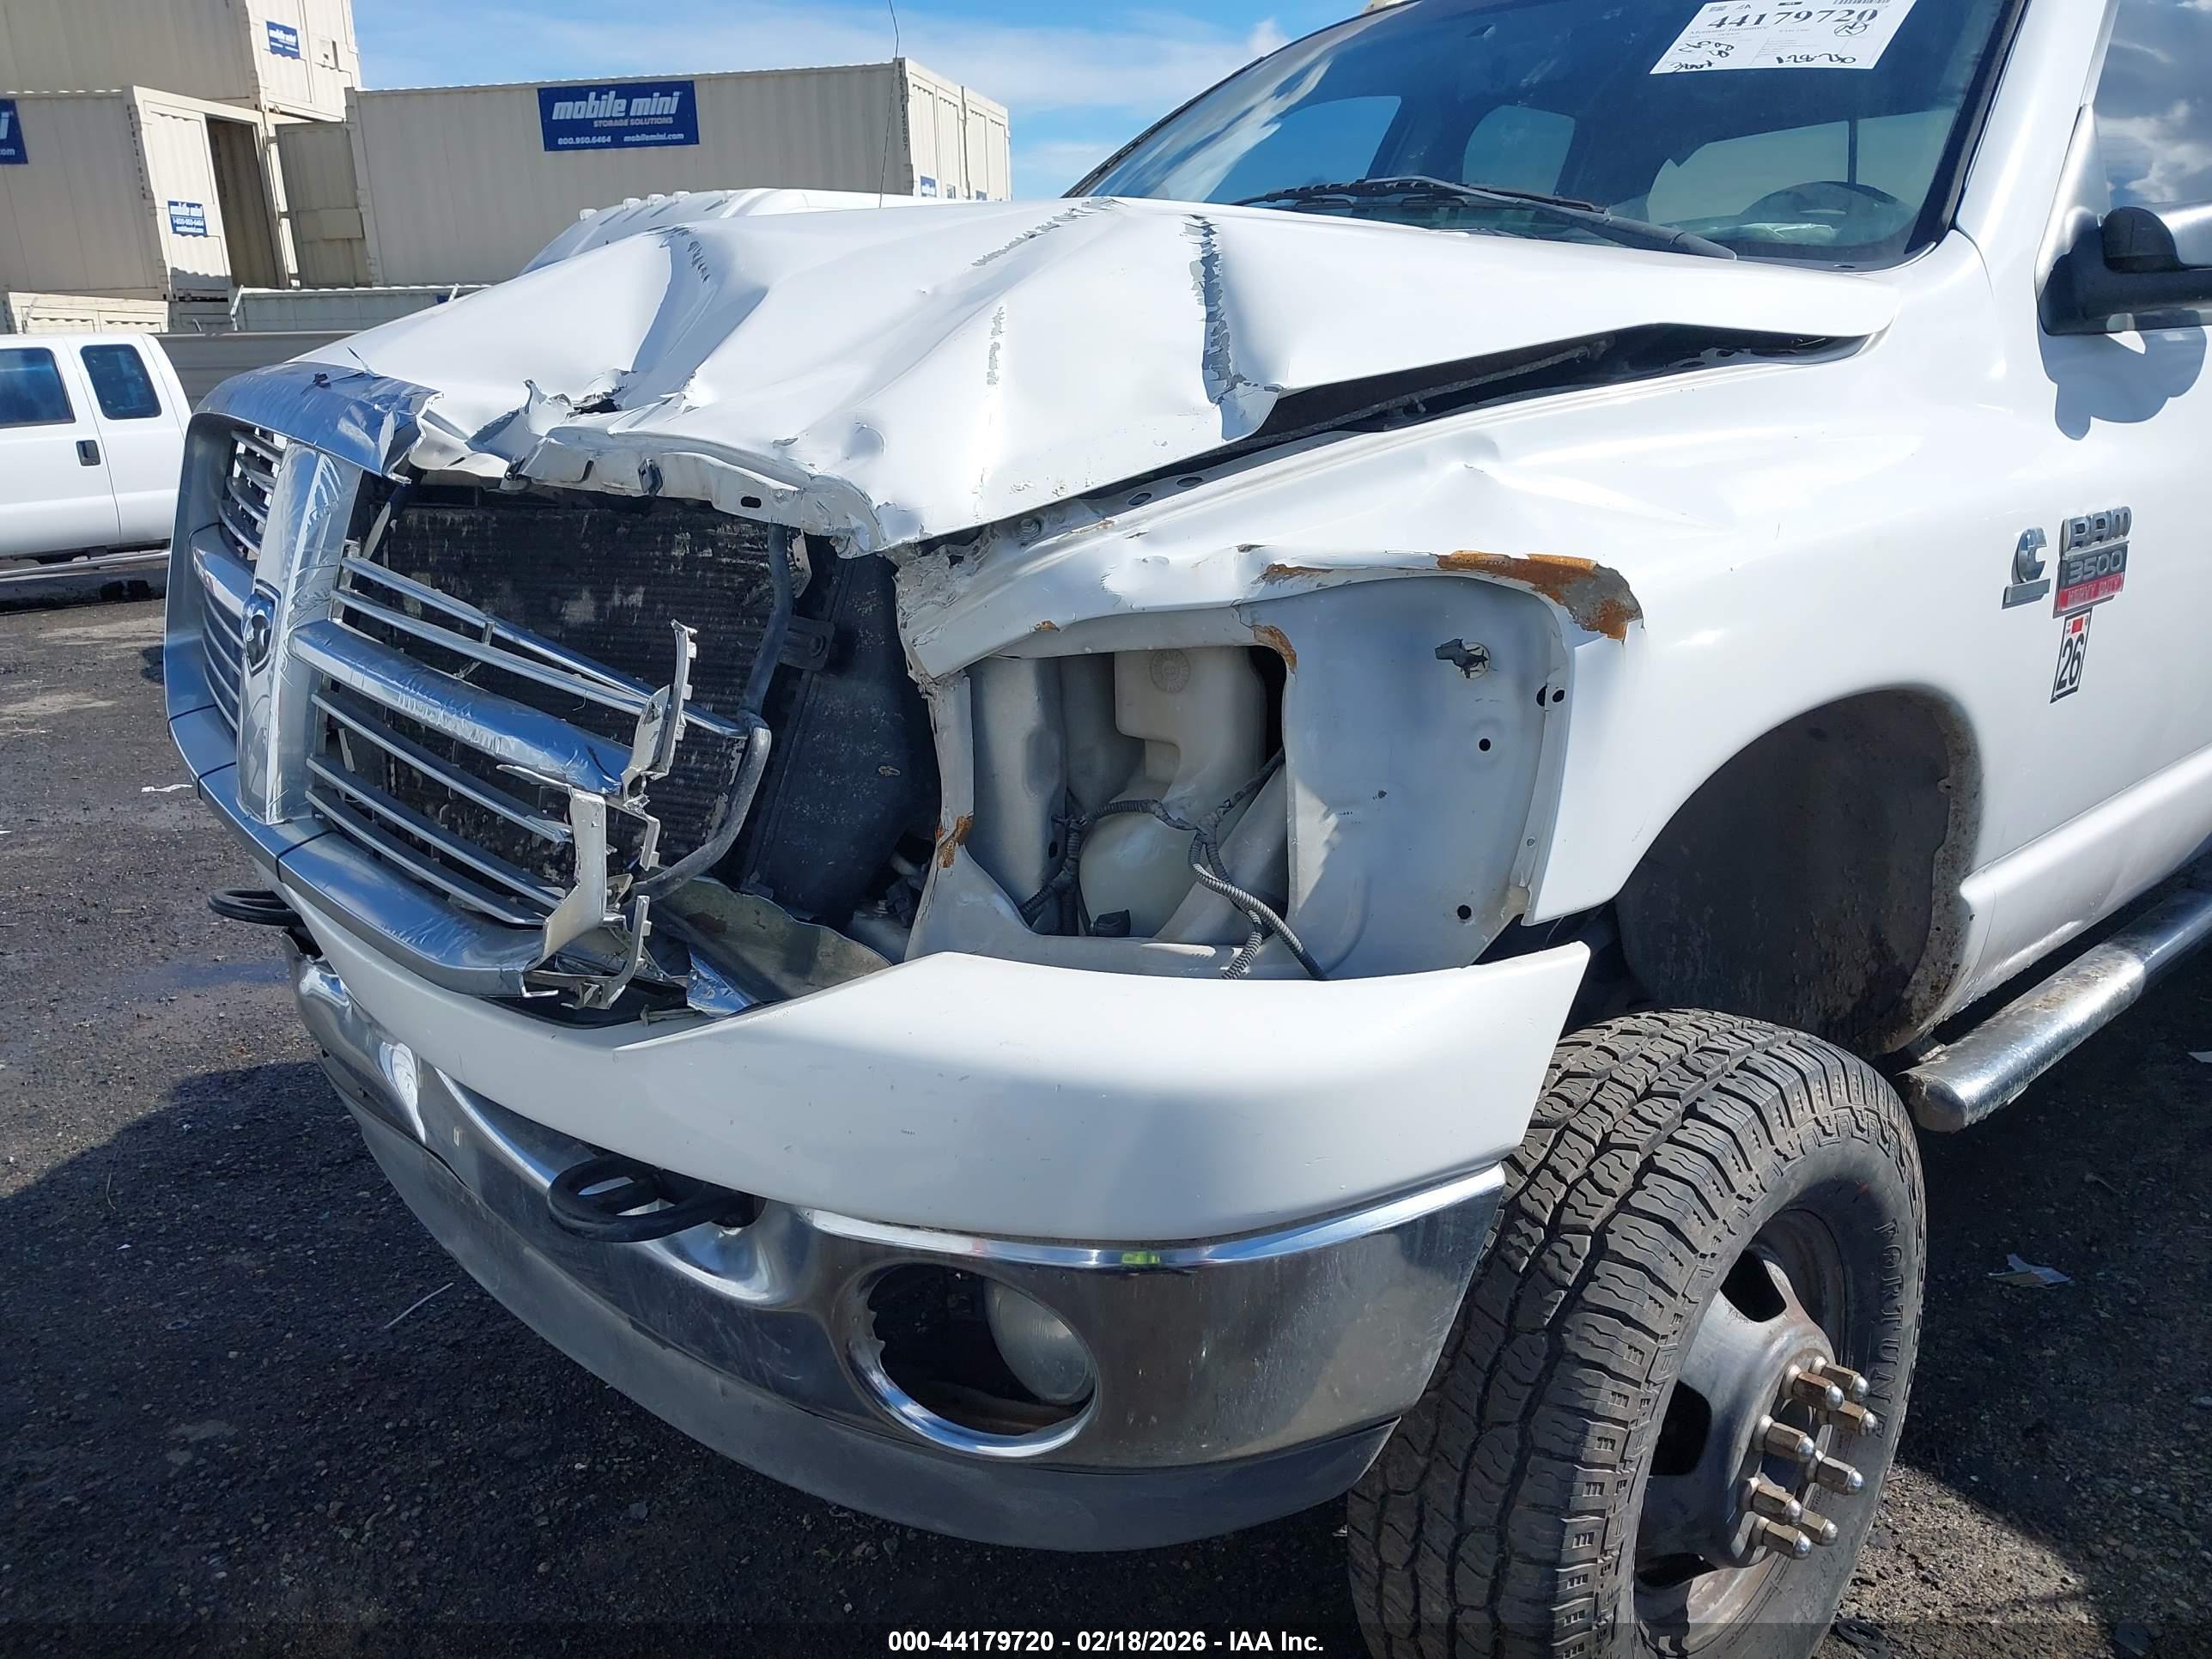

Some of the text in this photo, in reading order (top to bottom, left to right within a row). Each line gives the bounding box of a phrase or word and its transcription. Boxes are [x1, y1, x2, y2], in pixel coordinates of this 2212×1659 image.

[1707, 9, 1878, 28] 44179720
[551, 90, 680, 120] mobile mini
[593, 117, 674, 128] STORAGE SOLUTIONS
[623, 132, 684, 143] mobilemini.com
[2065, 506, 2132, 551] RAM
[2069, 549, 2124, 584] 3500
[2056, 633, 2085, 691] 26
[1869, 1218, 1904, 1439] FORTUNE
